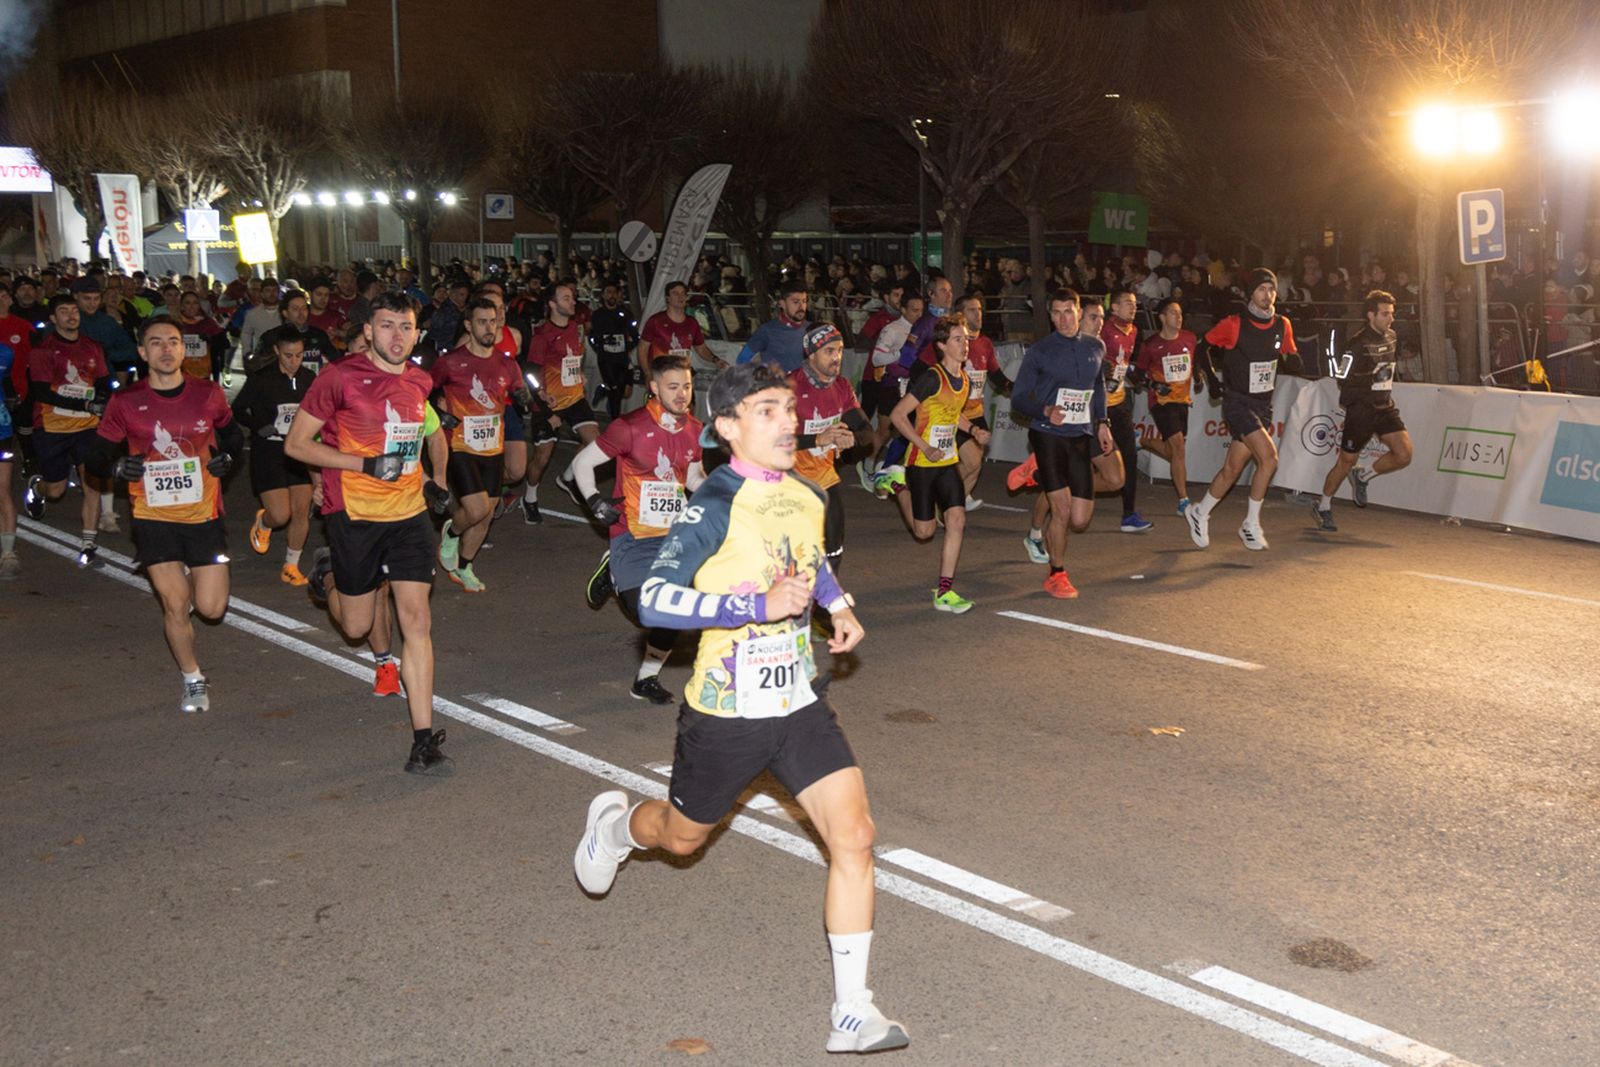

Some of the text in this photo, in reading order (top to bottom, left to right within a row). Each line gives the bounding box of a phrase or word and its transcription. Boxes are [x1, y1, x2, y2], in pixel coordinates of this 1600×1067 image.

[1104, 208, 1136, 231] WC
[1469, 199, 1496, 255] P
[473, 427, 496, 440] 5570
[1444, 441, 1505, 466] ALISEA
[155, 475, 193, 491] 3265
[650, 498, 682, 513] 5258
